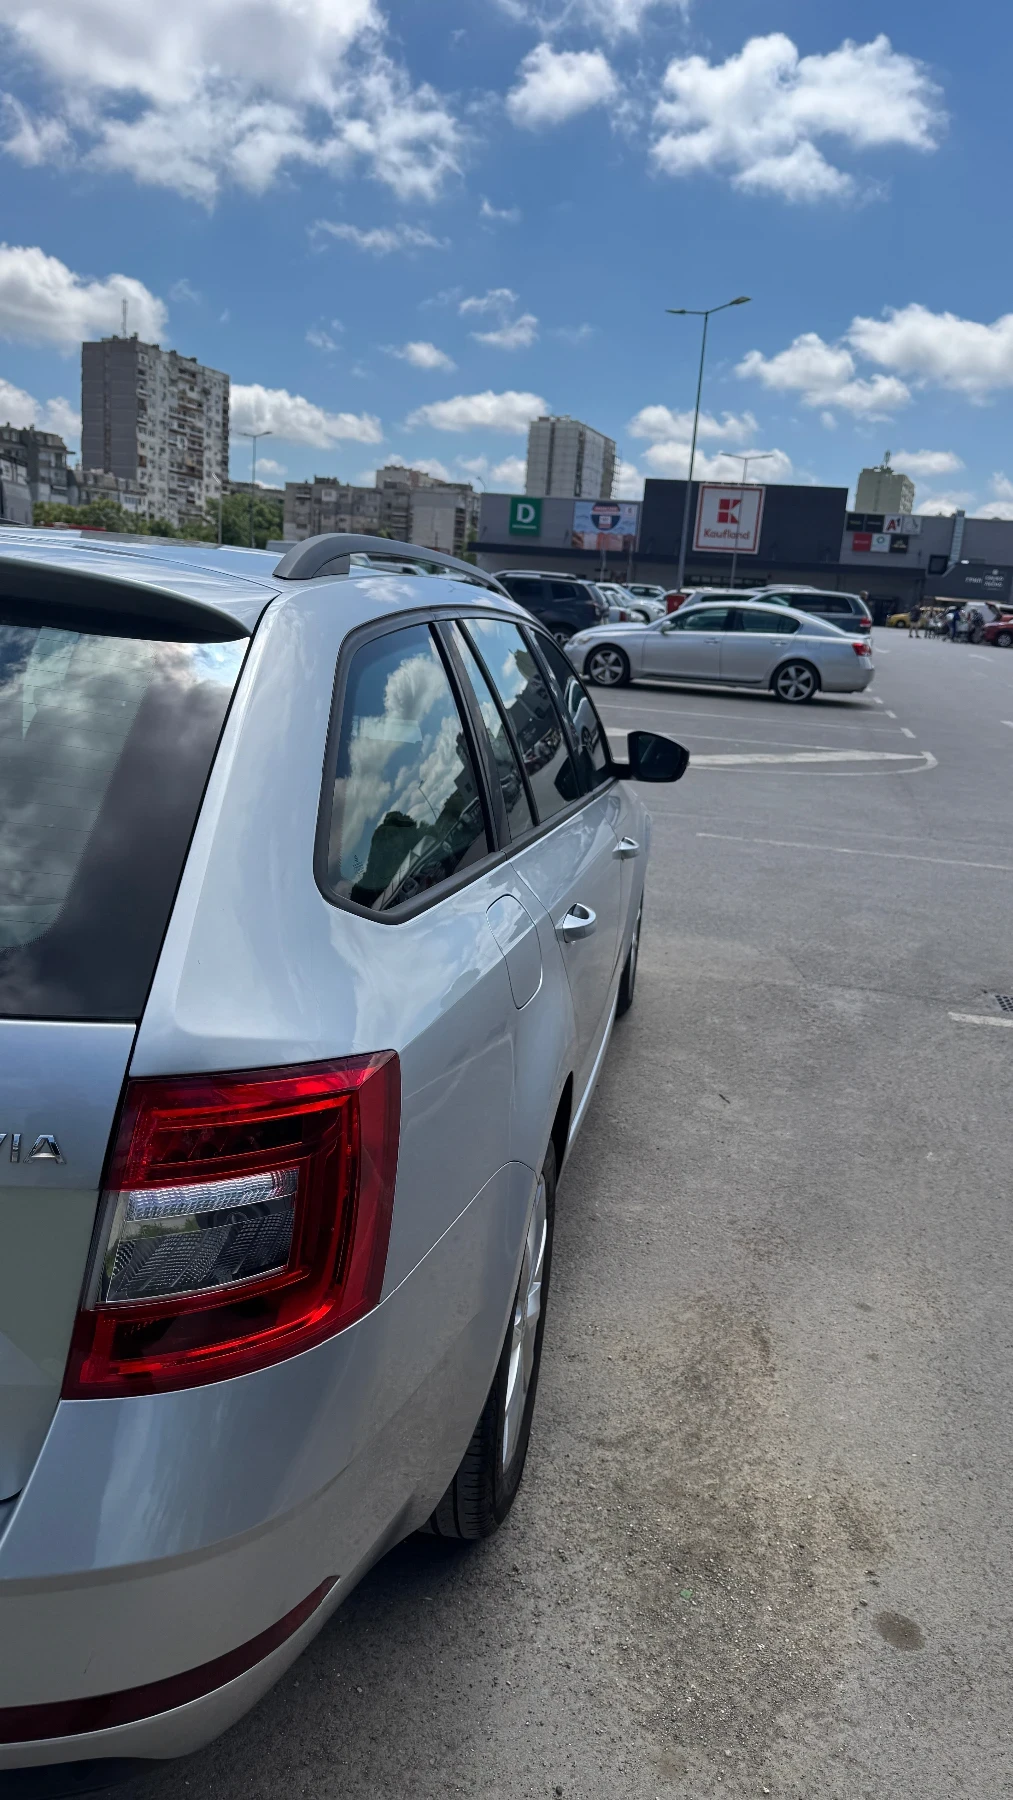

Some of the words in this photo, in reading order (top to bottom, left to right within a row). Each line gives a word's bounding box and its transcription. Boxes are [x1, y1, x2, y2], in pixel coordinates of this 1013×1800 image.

[517, 503, 536, 523] D
[886, 518, 901, 531] A1
[704, 529, 750, 540] Kaufland
